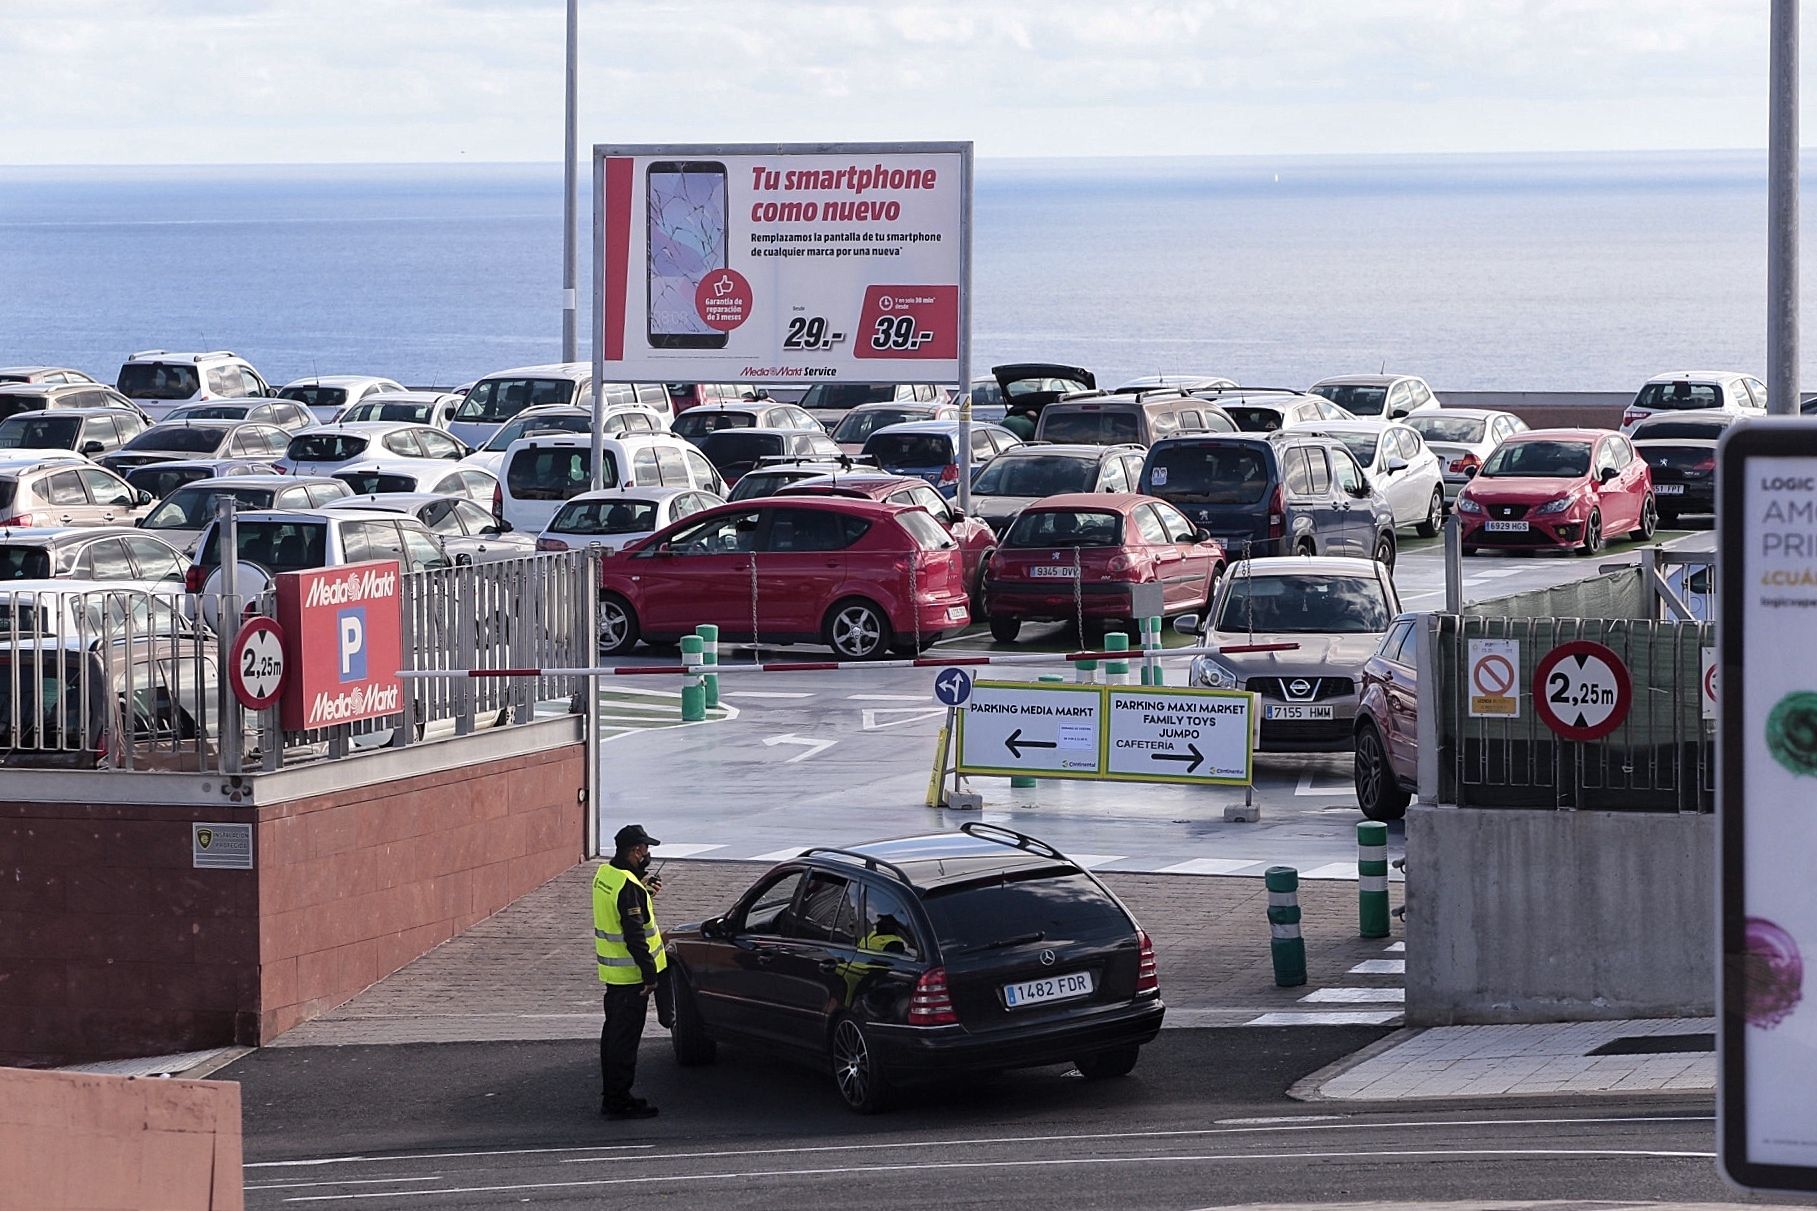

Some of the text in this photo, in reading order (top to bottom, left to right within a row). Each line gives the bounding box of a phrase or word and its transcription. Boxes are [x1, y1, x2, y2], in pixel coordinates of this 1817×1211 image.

[752, 164, 937, 194] Tu smartphone
[751, 200, 901, 222] como nuevo
[751, 232, 942, 243] Remplazamos la pantalla de tu smartphone
[751, 247, 762, 257] de
[763, 246, 805, 258] cualquier
[806, 247, 834, 256] marca
[836, 248, 852, 258] por
[853, 248, 870, 256] una
[734, 297, 743, 305] de
[707, 313, 715, 321] de
[715, 313, 719, 321] 3
[783, 317, 847, 351] 29.-
[871, 315, 934, 350] 39.-
[803, 366, 837, 377] Service
[1762, 500, 1817, 524] AM
[1490, 522, 1528, 530] 6929 HGS
[1762, 533, 1817, 558] PRI
[1037, 567, 1057, 577] 9345
[1761, 567, 1817, 586] ¿CUÁ
[341, 616, 363, 674] P
[243, 648, 281, 679] 2,25m
[1549, 672, 1614, 706] 2,25m
[970, 703, 1094, 717] PARKING MEDIA MARKT
[1115, 699, 1245, 715] PARKING MAXI MARKET
[1274, 706, 1331, 718] 7155 HMM
[1143, 714, 1216, 727] FAMILY TOYS
[1158, 728, 1200, 739] JUMPO
[1116, 739, 1174, 751] CAFETERÍA
[1018, 975, 1087, 1001] 1482 FDR
